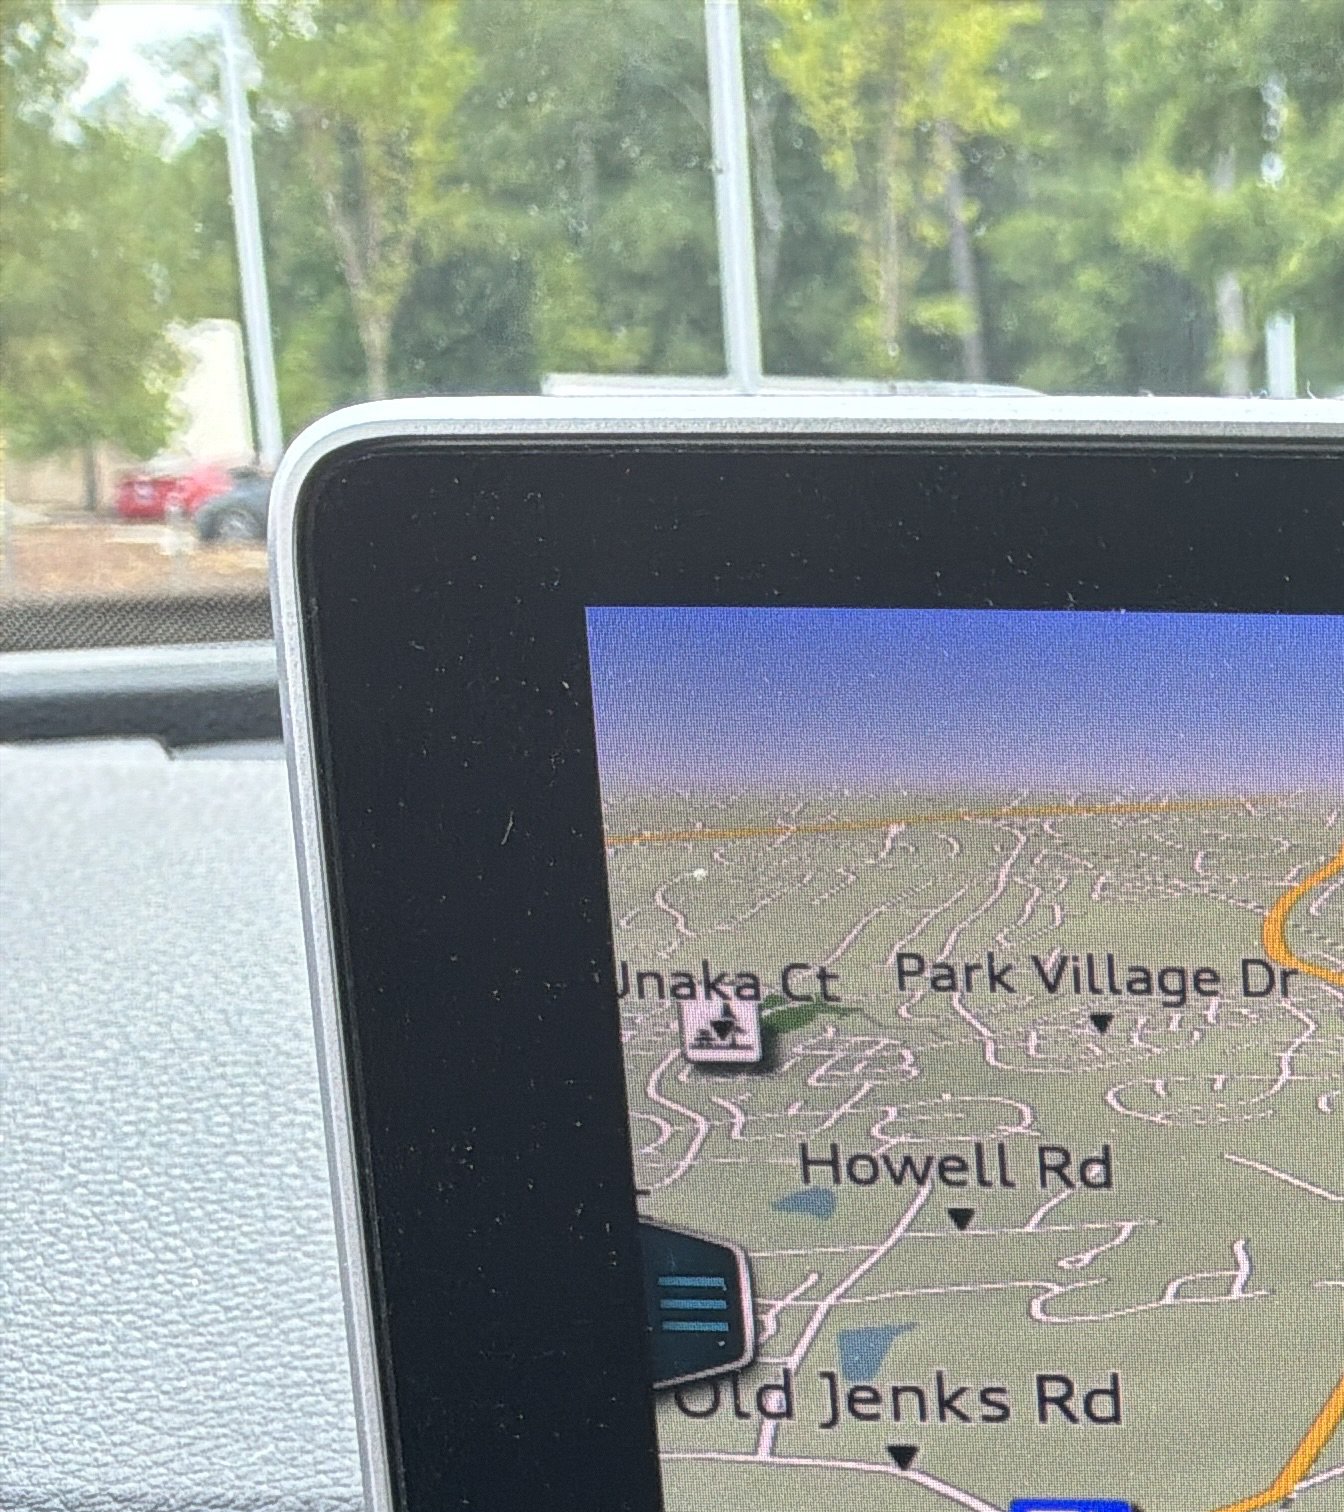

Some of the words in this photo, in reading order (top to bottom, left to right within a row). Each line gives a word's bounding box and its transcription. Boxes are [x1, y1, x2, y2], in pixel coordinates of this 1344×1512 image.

[780, 962, 841, 1002] Ct
[897, 952, 1013, 993] Park
[1031, 953, 1221, 1008] Village
[1240, 957, 1299, 998] Dr
[802, 1143, 1010, 1187] Howell
[1039, 1144, 1112, 1189] Rd
[819, 1369, 1011, 1428] Jenks
[1036, 1373, 1122, 1425] Rd
